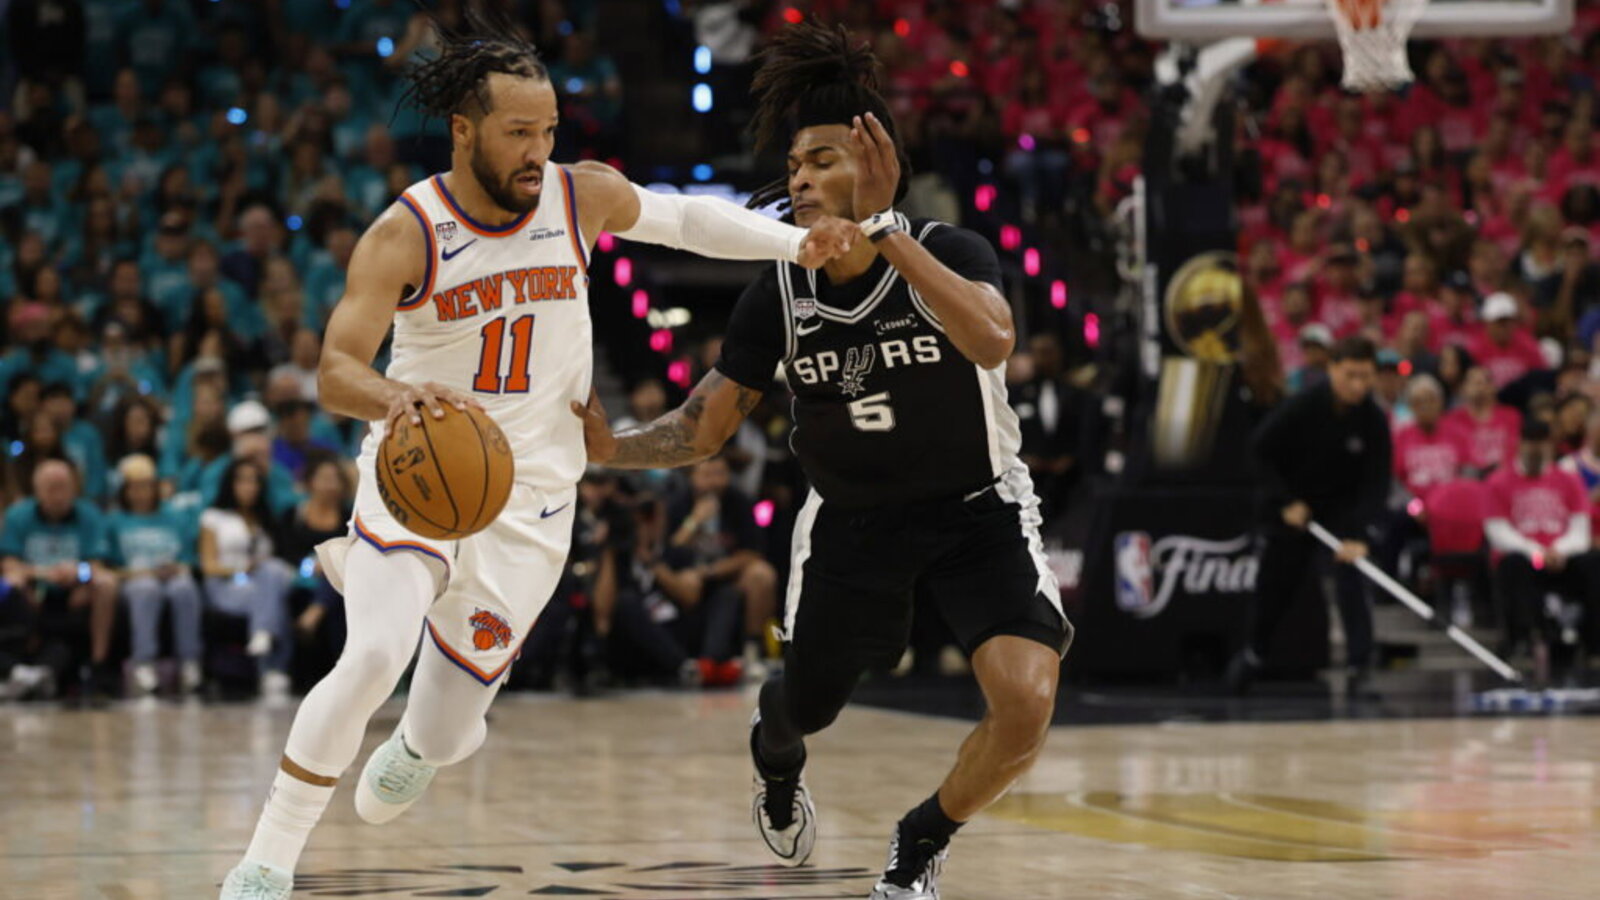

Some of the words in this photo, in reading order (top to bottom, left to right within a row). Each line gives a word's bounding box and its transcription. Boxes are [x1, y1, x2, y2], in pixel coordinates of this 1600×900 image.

[433, 273, 505, 322] NEW
[505, 265, 578, 305] YORK
[472, 314, 535, 394] 11
[848, 391, 896, 432] 5
[1136, 534, 1262, 618] Fina
